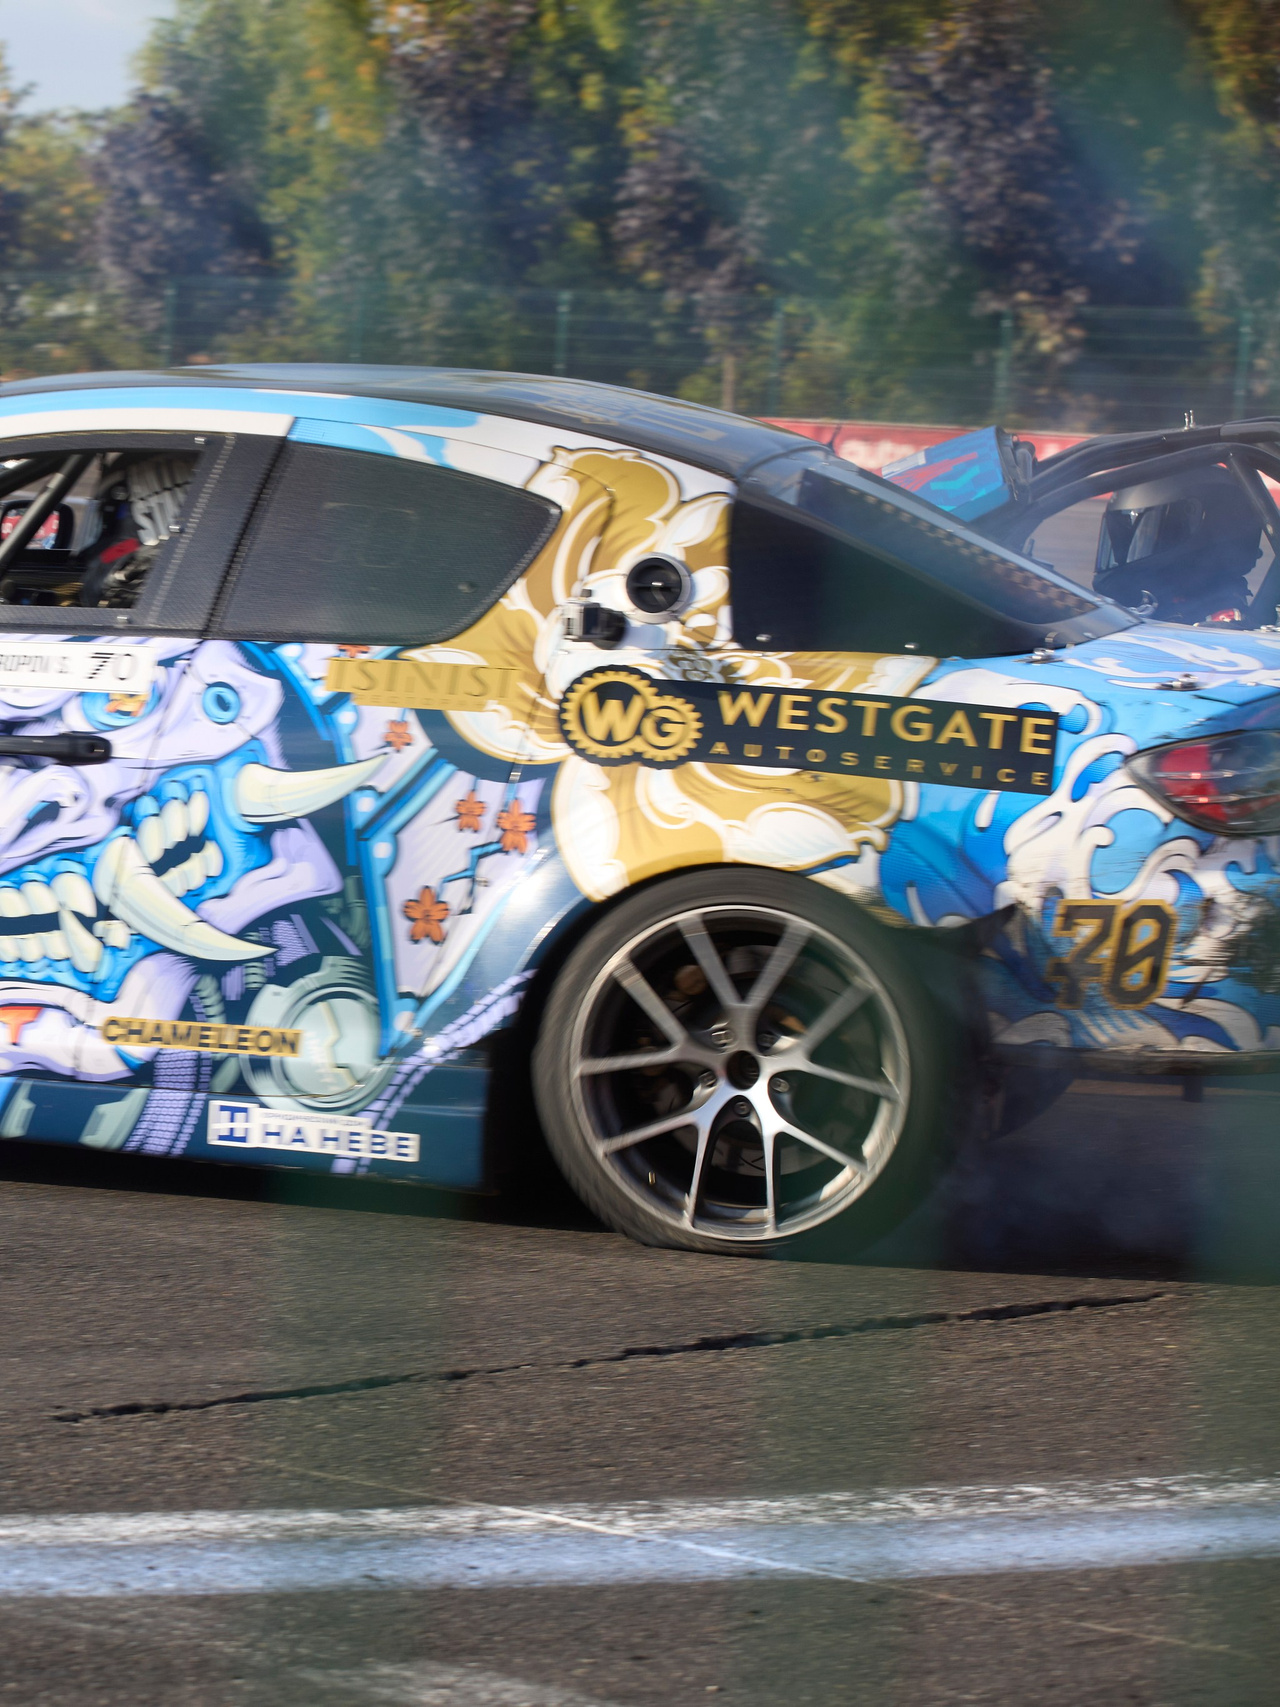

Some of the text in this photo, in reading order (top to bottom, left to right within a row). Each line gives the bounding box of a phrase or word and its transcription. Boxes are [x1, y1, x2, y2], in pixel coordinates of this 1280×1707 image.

[88, 652, 139, 680] 70
[717, 690, 1055, 756] WESTGATE
[709, 741, 1050, 787] AUTOSERVICE
[1045, 899, 1178, 1010] 70
[104, 1019, 297, 1053] CHAMELEON
